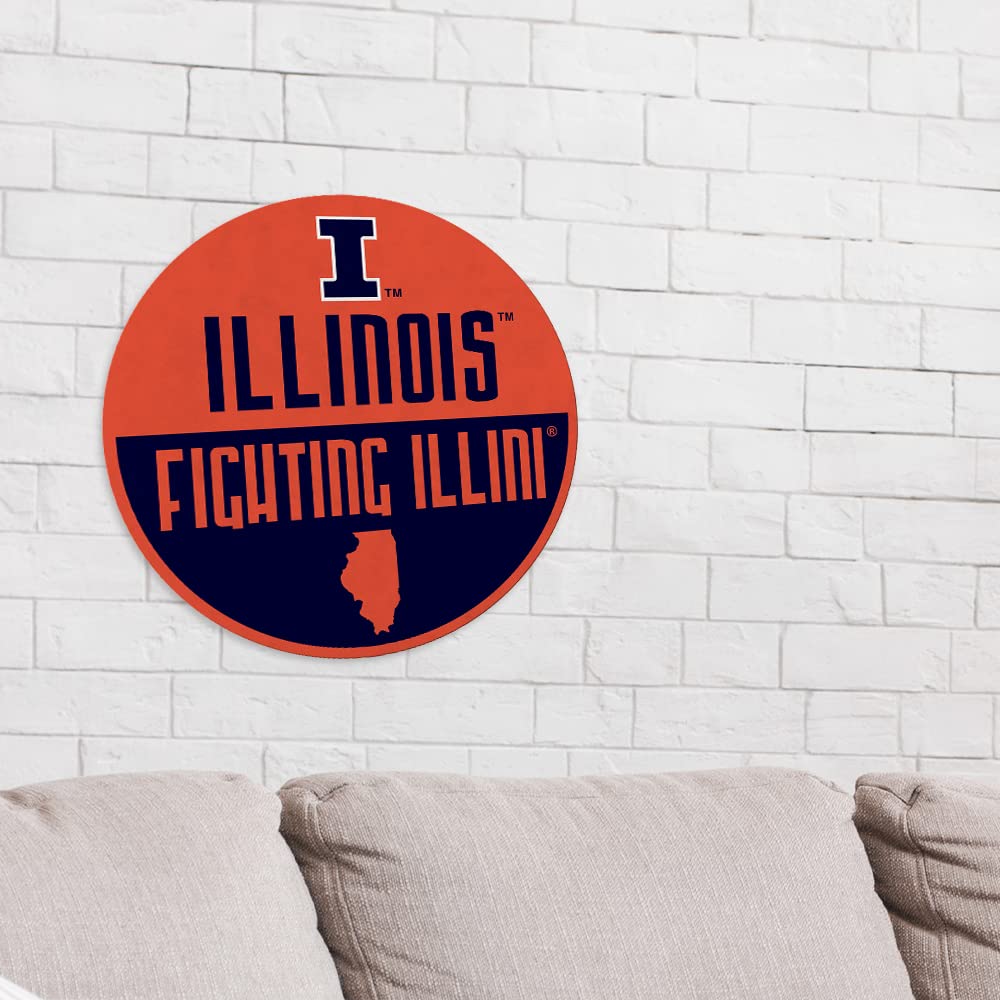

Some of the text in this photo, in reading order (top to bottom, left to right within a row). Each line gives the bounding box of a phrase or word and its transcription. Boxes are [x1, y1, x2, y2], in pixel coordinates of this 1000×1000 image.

[316, 216, 381, 301] I
[204, 310, 498, 412] ILLINOIS
[156, 437, 391, 531] FIGHTING
[411, 427, 546, 509] ILLINI
